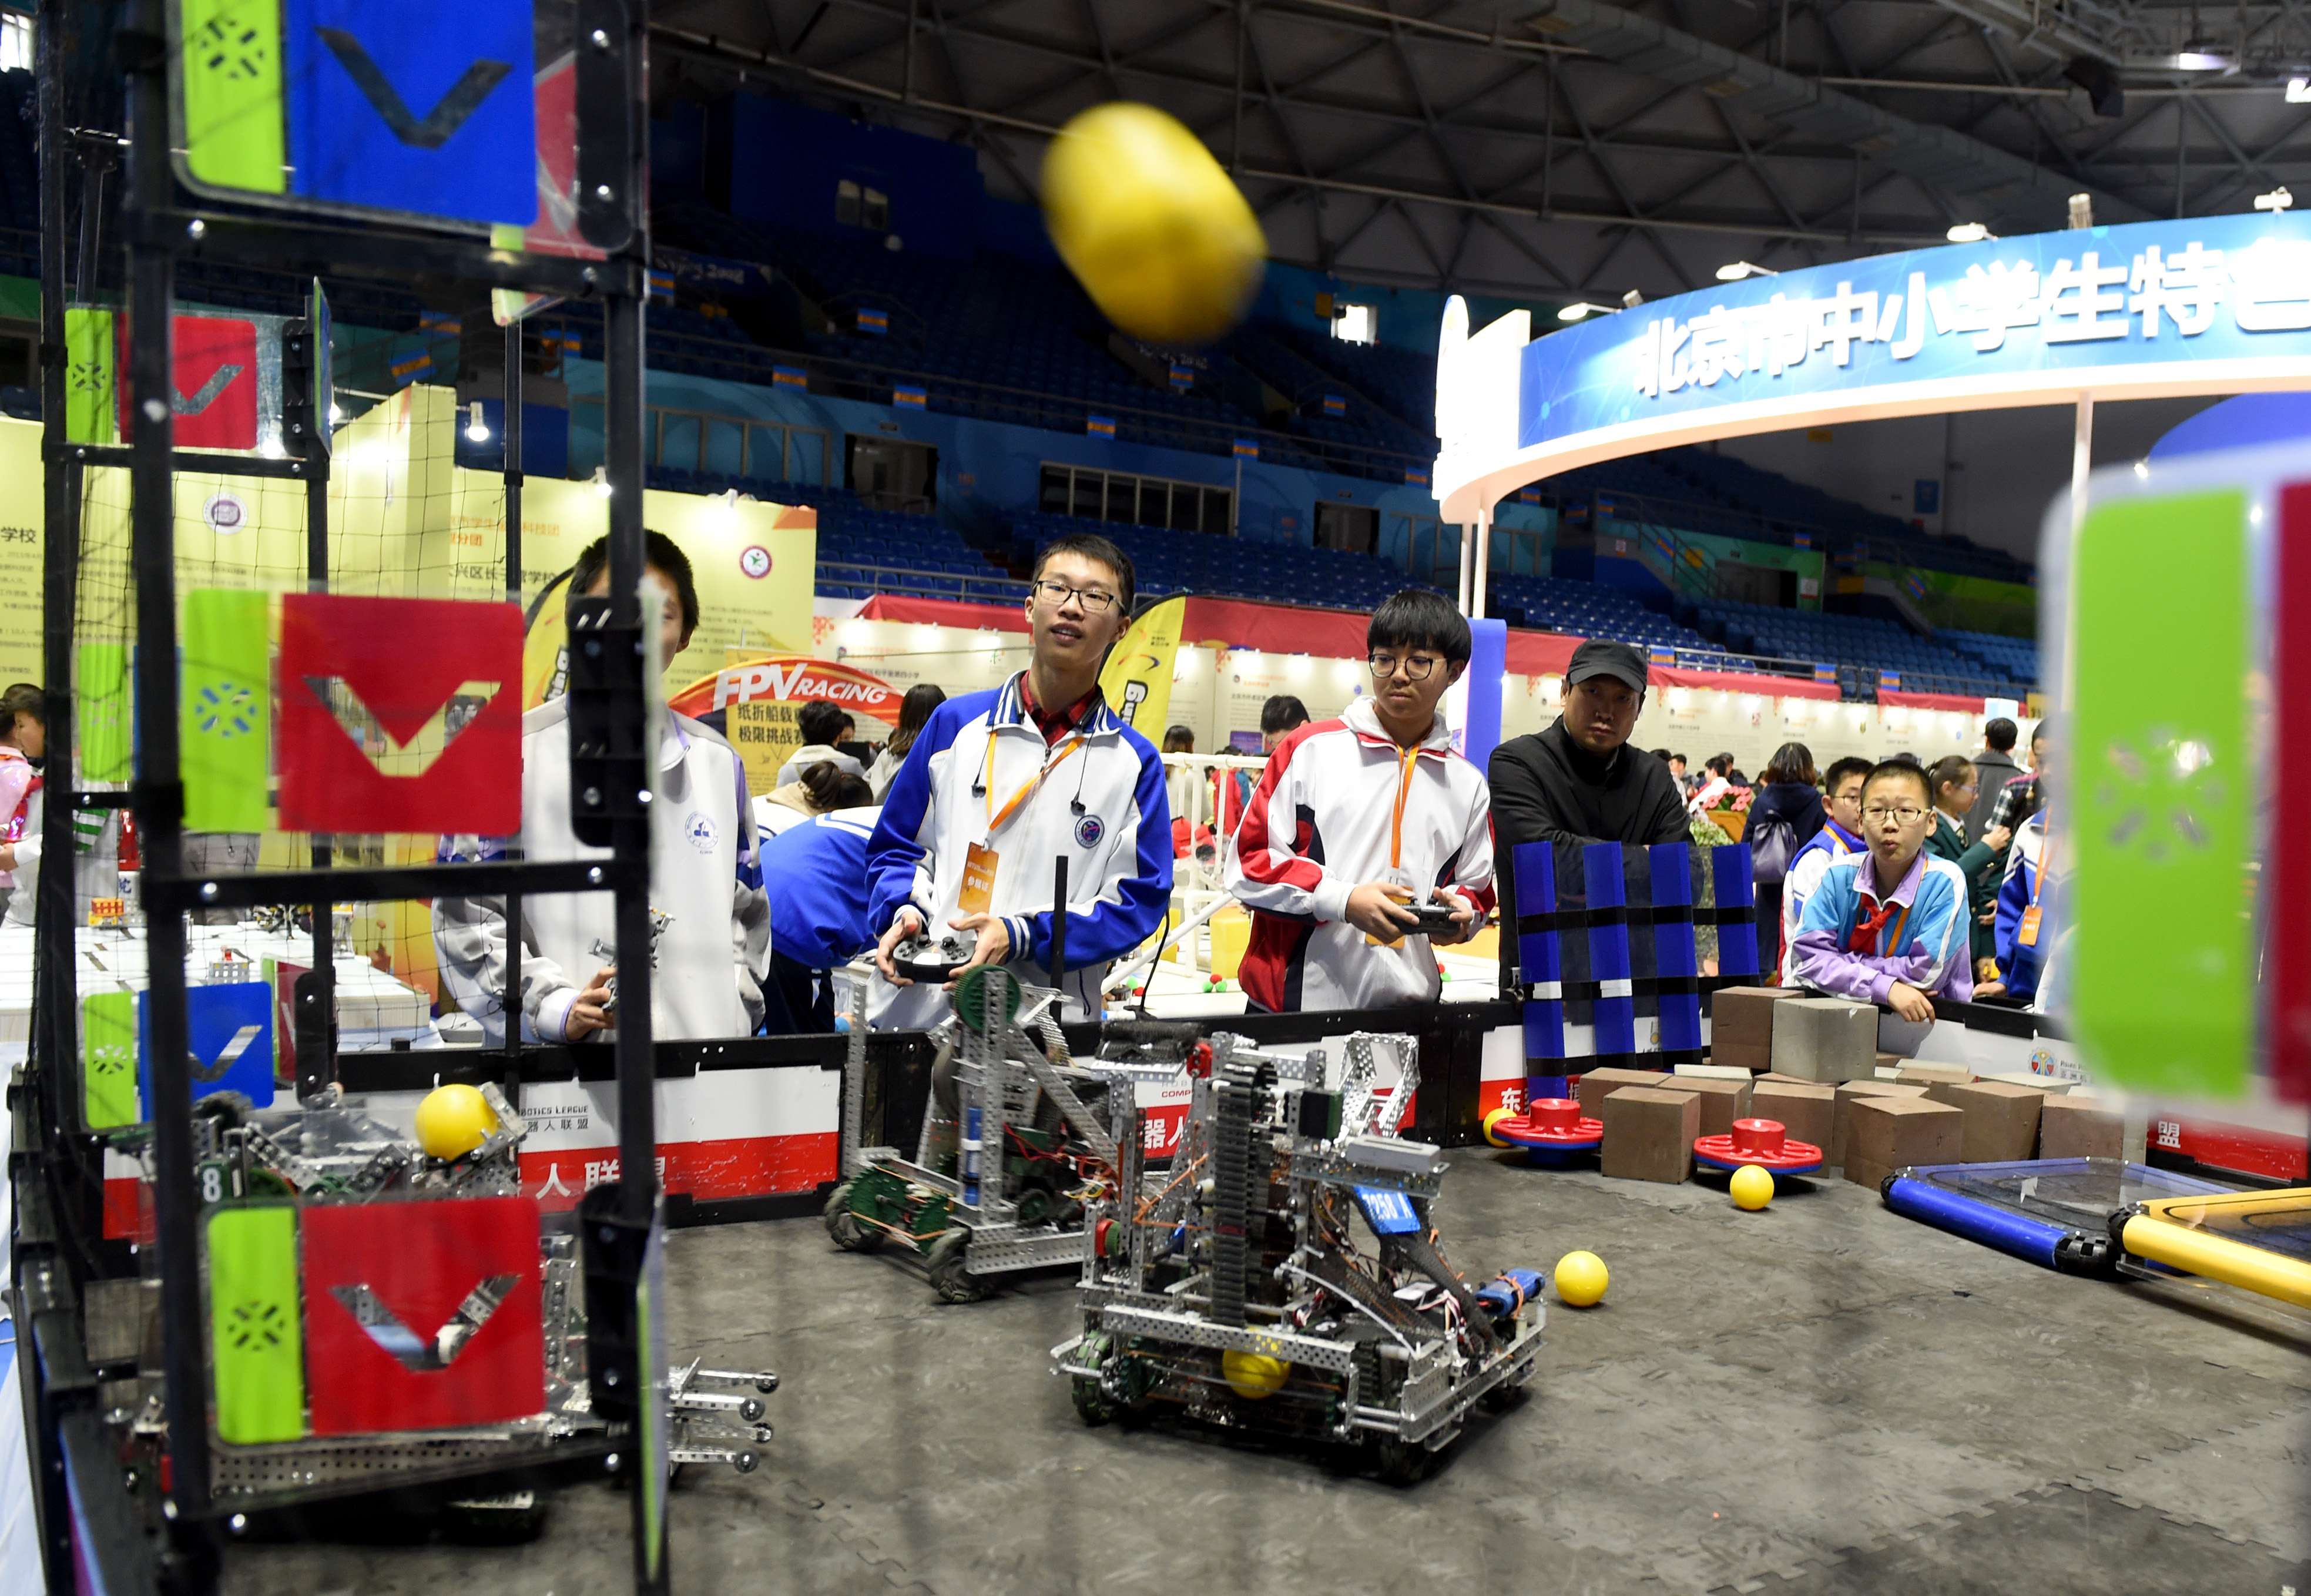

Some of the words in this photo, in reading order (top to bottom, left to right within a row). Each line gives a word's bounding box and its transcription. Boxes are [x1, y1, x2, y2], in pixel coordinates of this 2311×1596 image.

[713, 663, 809, 712] FPV
[794, 678, 888, 704] RACING
[1162, 1089, 1192, 1098] COMP
[519, 1107, 551, 1116] BOTICS
[556, 1105, 588, 1114] LEAGUE
[2156, 1121, 2181, 1149] 盟
